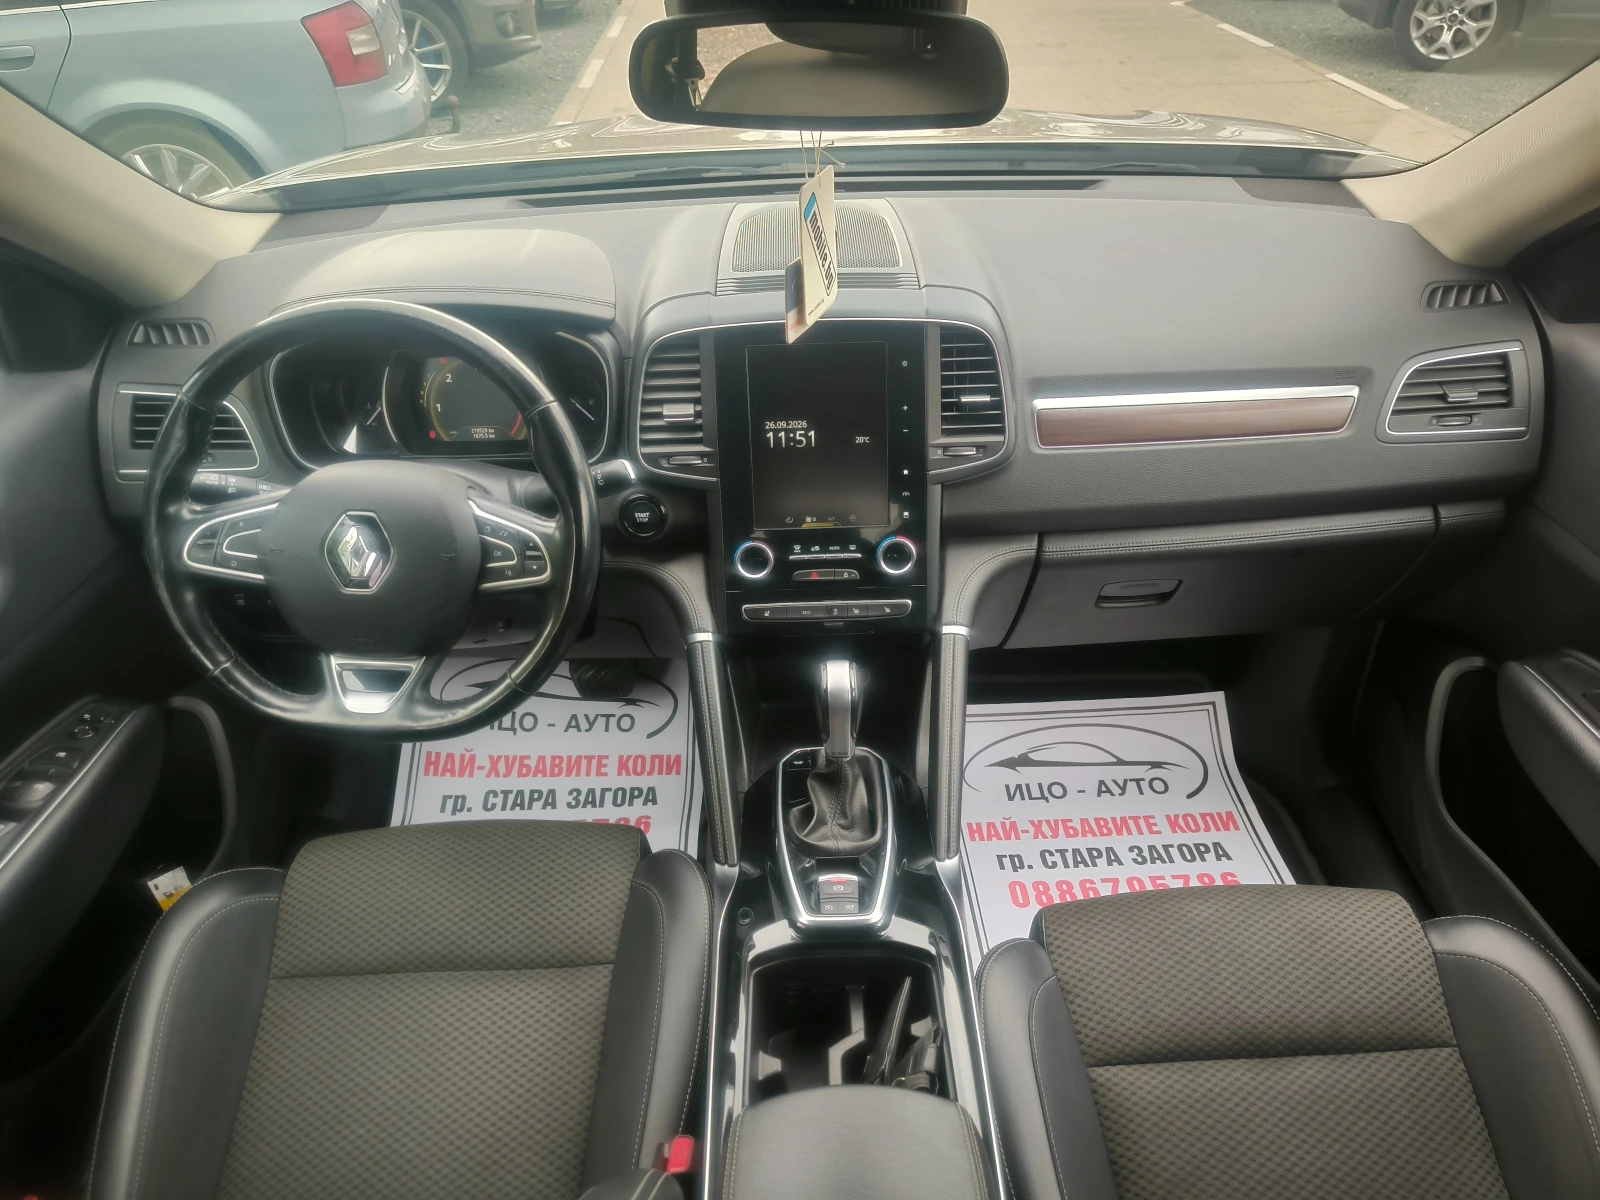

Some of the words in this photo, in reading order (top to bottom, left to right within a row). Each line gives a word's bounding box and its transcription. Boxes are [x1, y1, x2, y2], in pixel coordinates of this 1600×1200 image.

[809, 209, 834, 291] mobile.bg
[765, 420, 807, 429] 26.09.2026
[766, 430, 815, 448] 11:51
[563, 713, 636, 733] АУТО
[423, 748, 609, 778] НАЙ-ХУБАВИТЕ
[617, 754, 682, 777] КОЛИ
[439, 794, 472, 816] гр.
[481, 789, 557, 812] СТАРА
[566, 786, 658, 809] ЗАГОРА
[1004, 781, 1068, 803] ИЦО
[1096, 777, 1169, 798] АУТО
[966, 815, 1162, 842] НАЙ-ХУБАВИТЕ
[1165, 811, 1241, 834] КОЛИ
[996, 853, 1034, 873] гр.
[1039, 847, 1124, 870] СТАРА
[1128, 842, 1233, 865] ЗАГОРА
